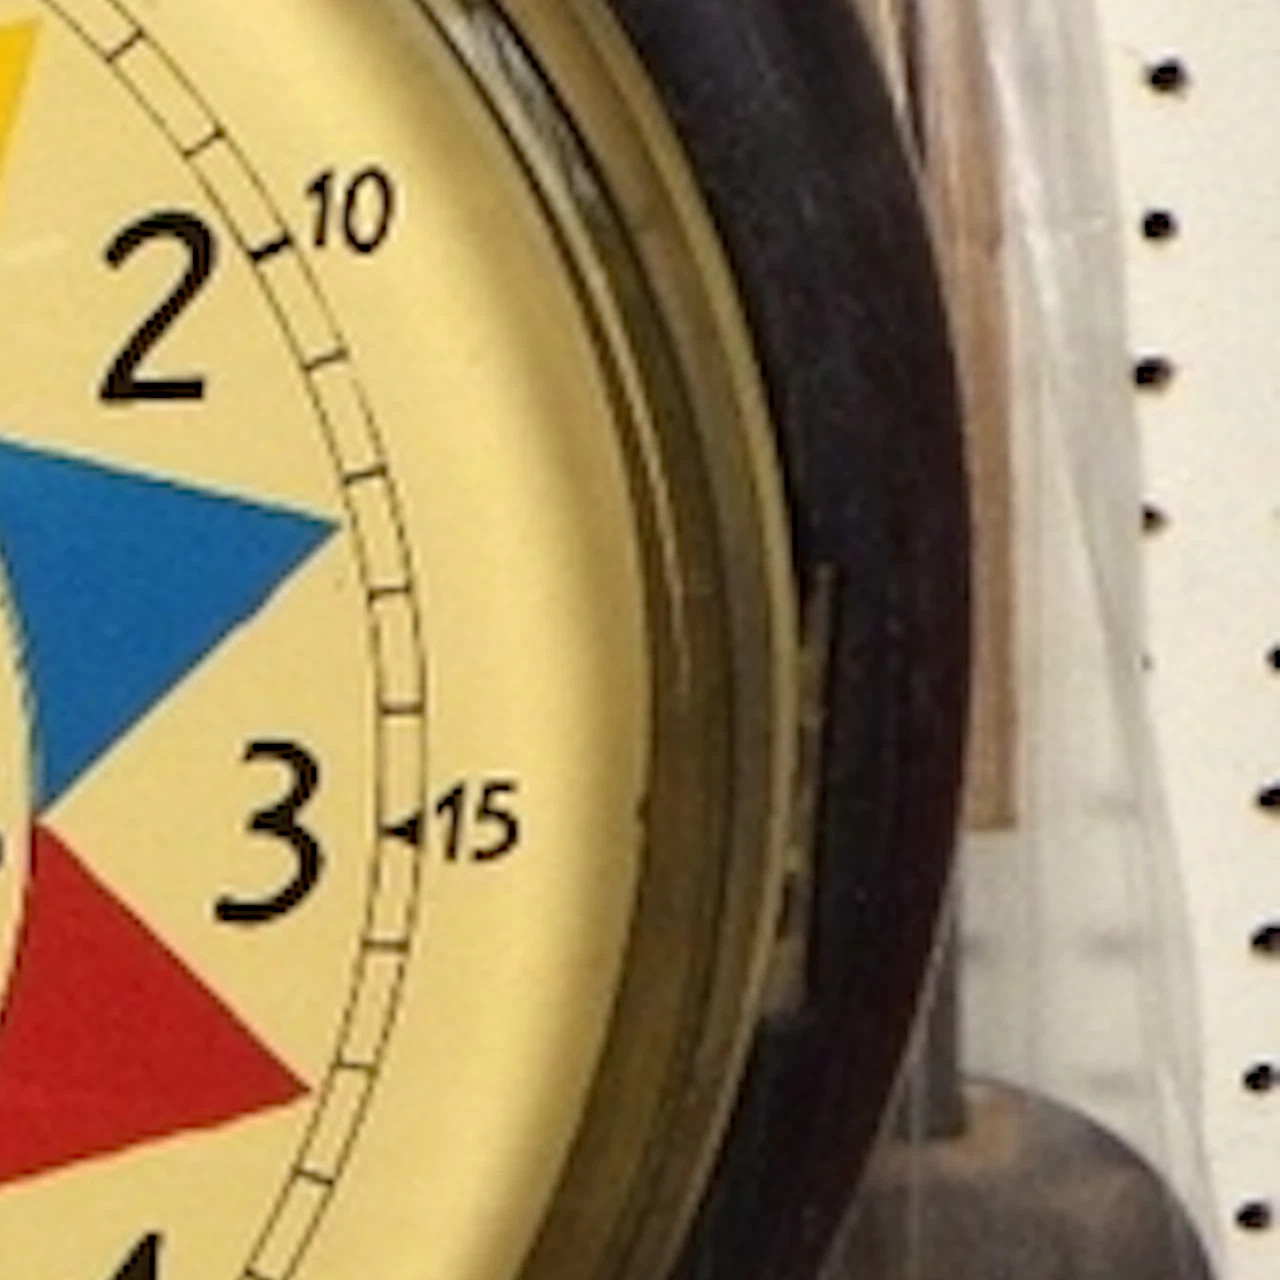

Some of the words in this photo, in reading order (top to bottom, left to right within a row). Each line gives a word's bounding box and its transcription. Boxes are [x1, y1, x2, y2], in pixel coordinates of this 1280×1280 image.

[306, 166, 394, 256] 10
[98, 209, 217, 405] 2
[213, 739, 326, 926] 3
[434, 780, 520, 863] 15
